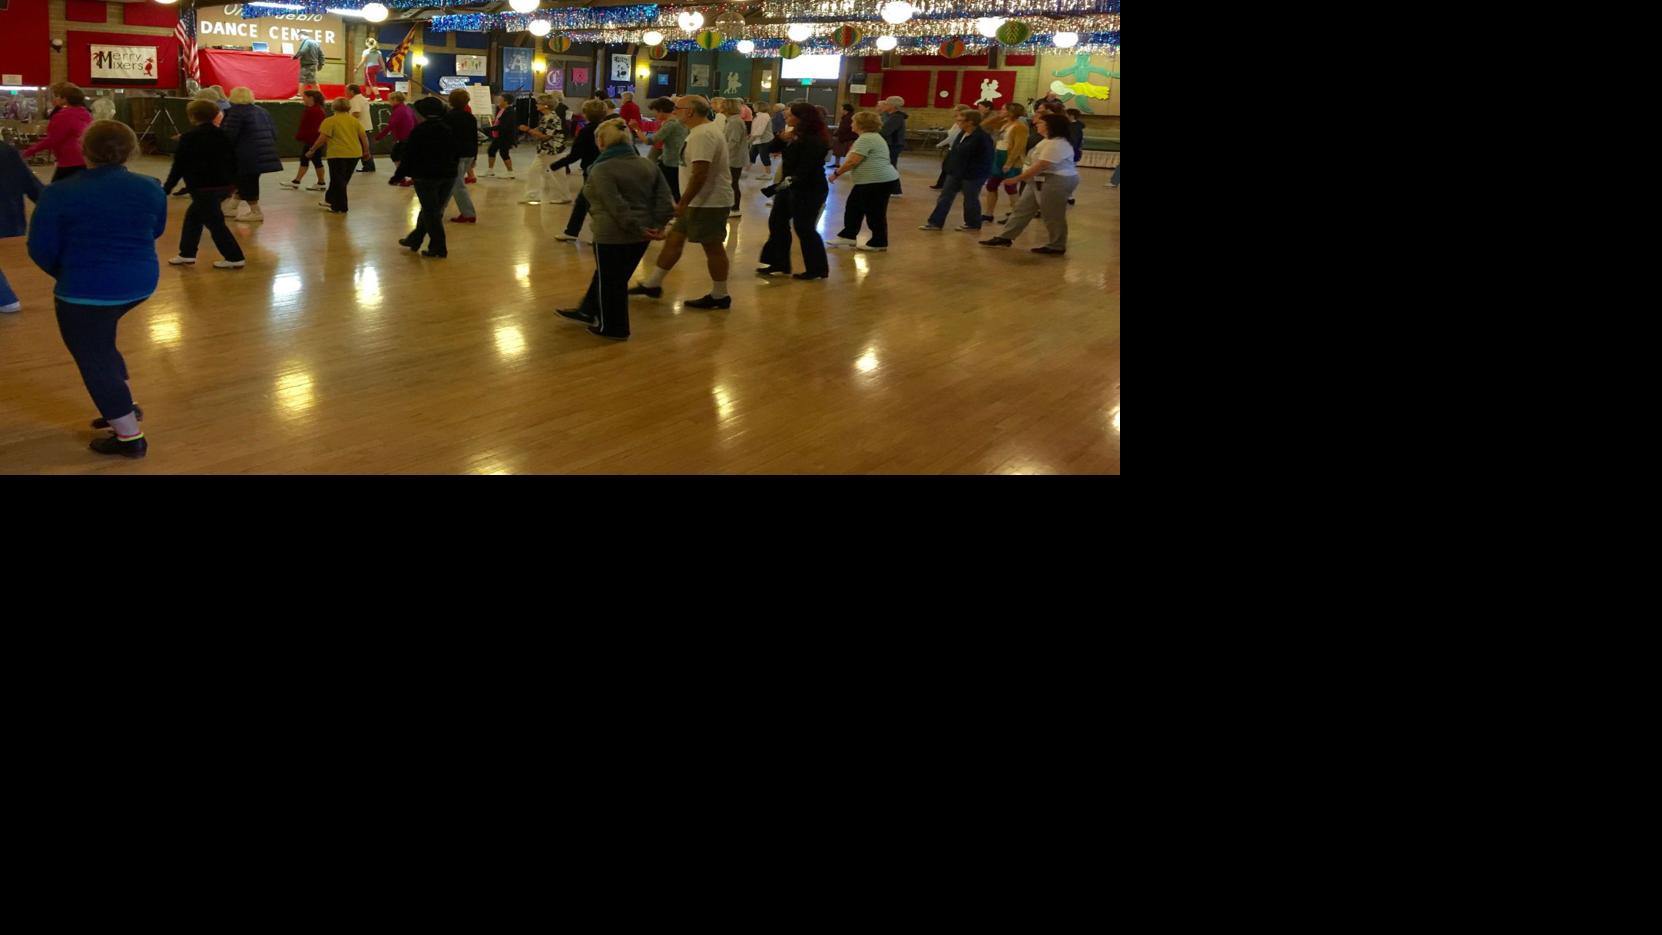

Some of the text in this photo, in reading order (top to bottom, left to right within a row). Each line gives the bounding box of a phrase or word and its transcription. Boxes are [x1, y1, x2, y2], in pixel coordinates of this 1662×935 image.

[200, 20, 258, 38] DANCE
[98, 51, 142, 64] Merry
[98, 57, 144, 71] Mixers
